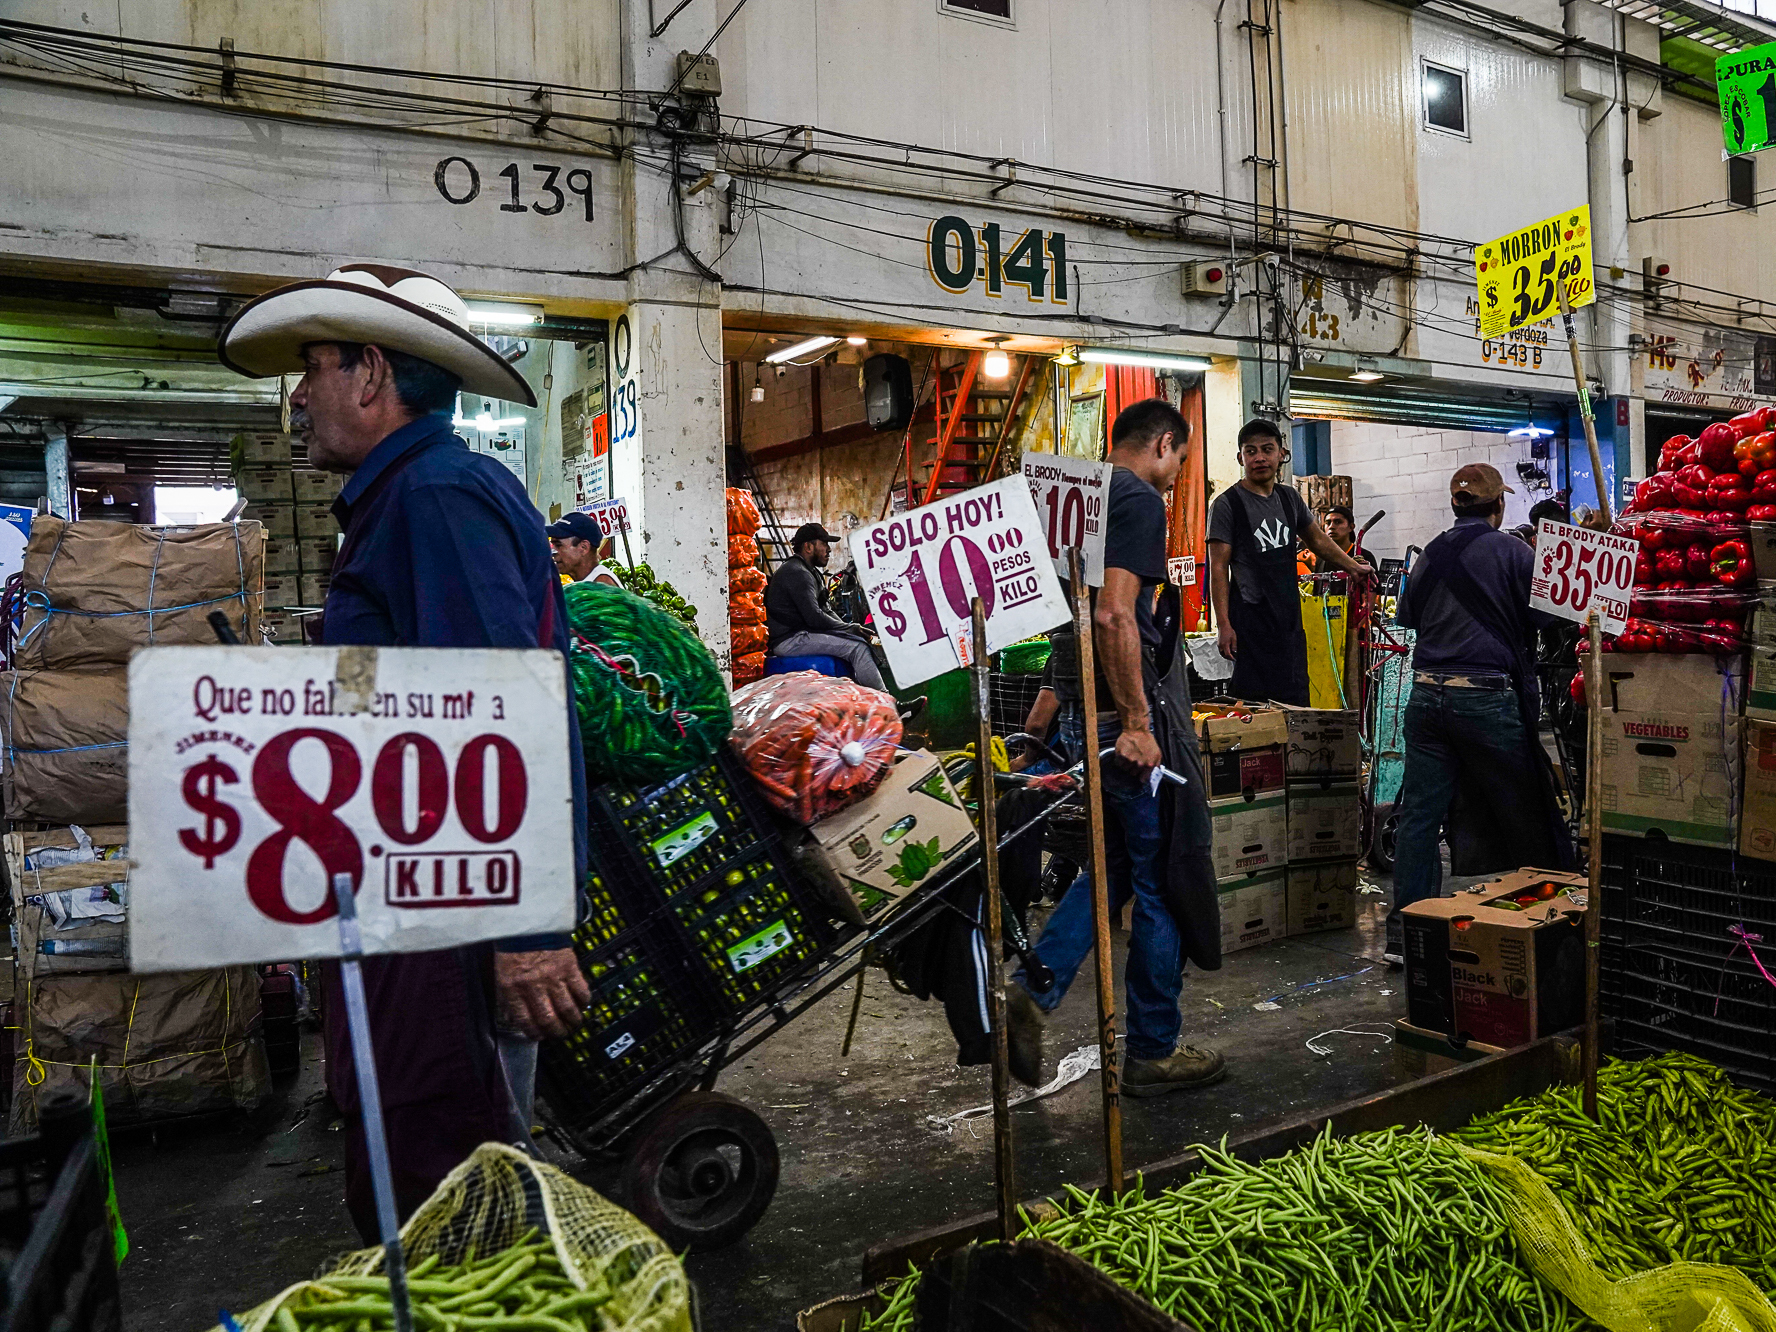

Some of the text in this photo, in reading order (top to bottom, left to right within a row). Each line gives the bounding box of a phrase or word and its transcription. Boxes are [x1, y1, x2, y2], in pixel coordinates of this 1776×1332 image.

[499, 162, 594, 222] 139
[1500, 220, 1561, 267] MORRON
[1532, 346, 1543, 369] B
[612, 379, 637, 444] 139
[1662, 389, 1710, 405] PRODUCTOR:
[1729, 397, 1757, 411] FRUTAS
[1024, 463, 1034, 478] EL
[1034, 465, 1062, 482] BRODY
[864, 492, 1004, 569] ¡SOLO HOY!
[1086, 518, 1098, 533] KILO
[1543, 522, 1556, 535] EL
[1597, 535, 1636, 554] ATAKA
[992, 551, 1031, 574] PESOS
[999, 575, 1039, 603] KILO
[194, 674, 253, 723] Que
[261, 689, 296, 716] no
[406, 691, 434, 719] su
[1622, 722, 1690, 739] VEGETABLES
[1242, 757, 1262, 768] Jack
[395, 856, 509, 899] KILO
[1452, 966, 1496, 987] Black
[1456, 988, 1489, 1007] Jack
